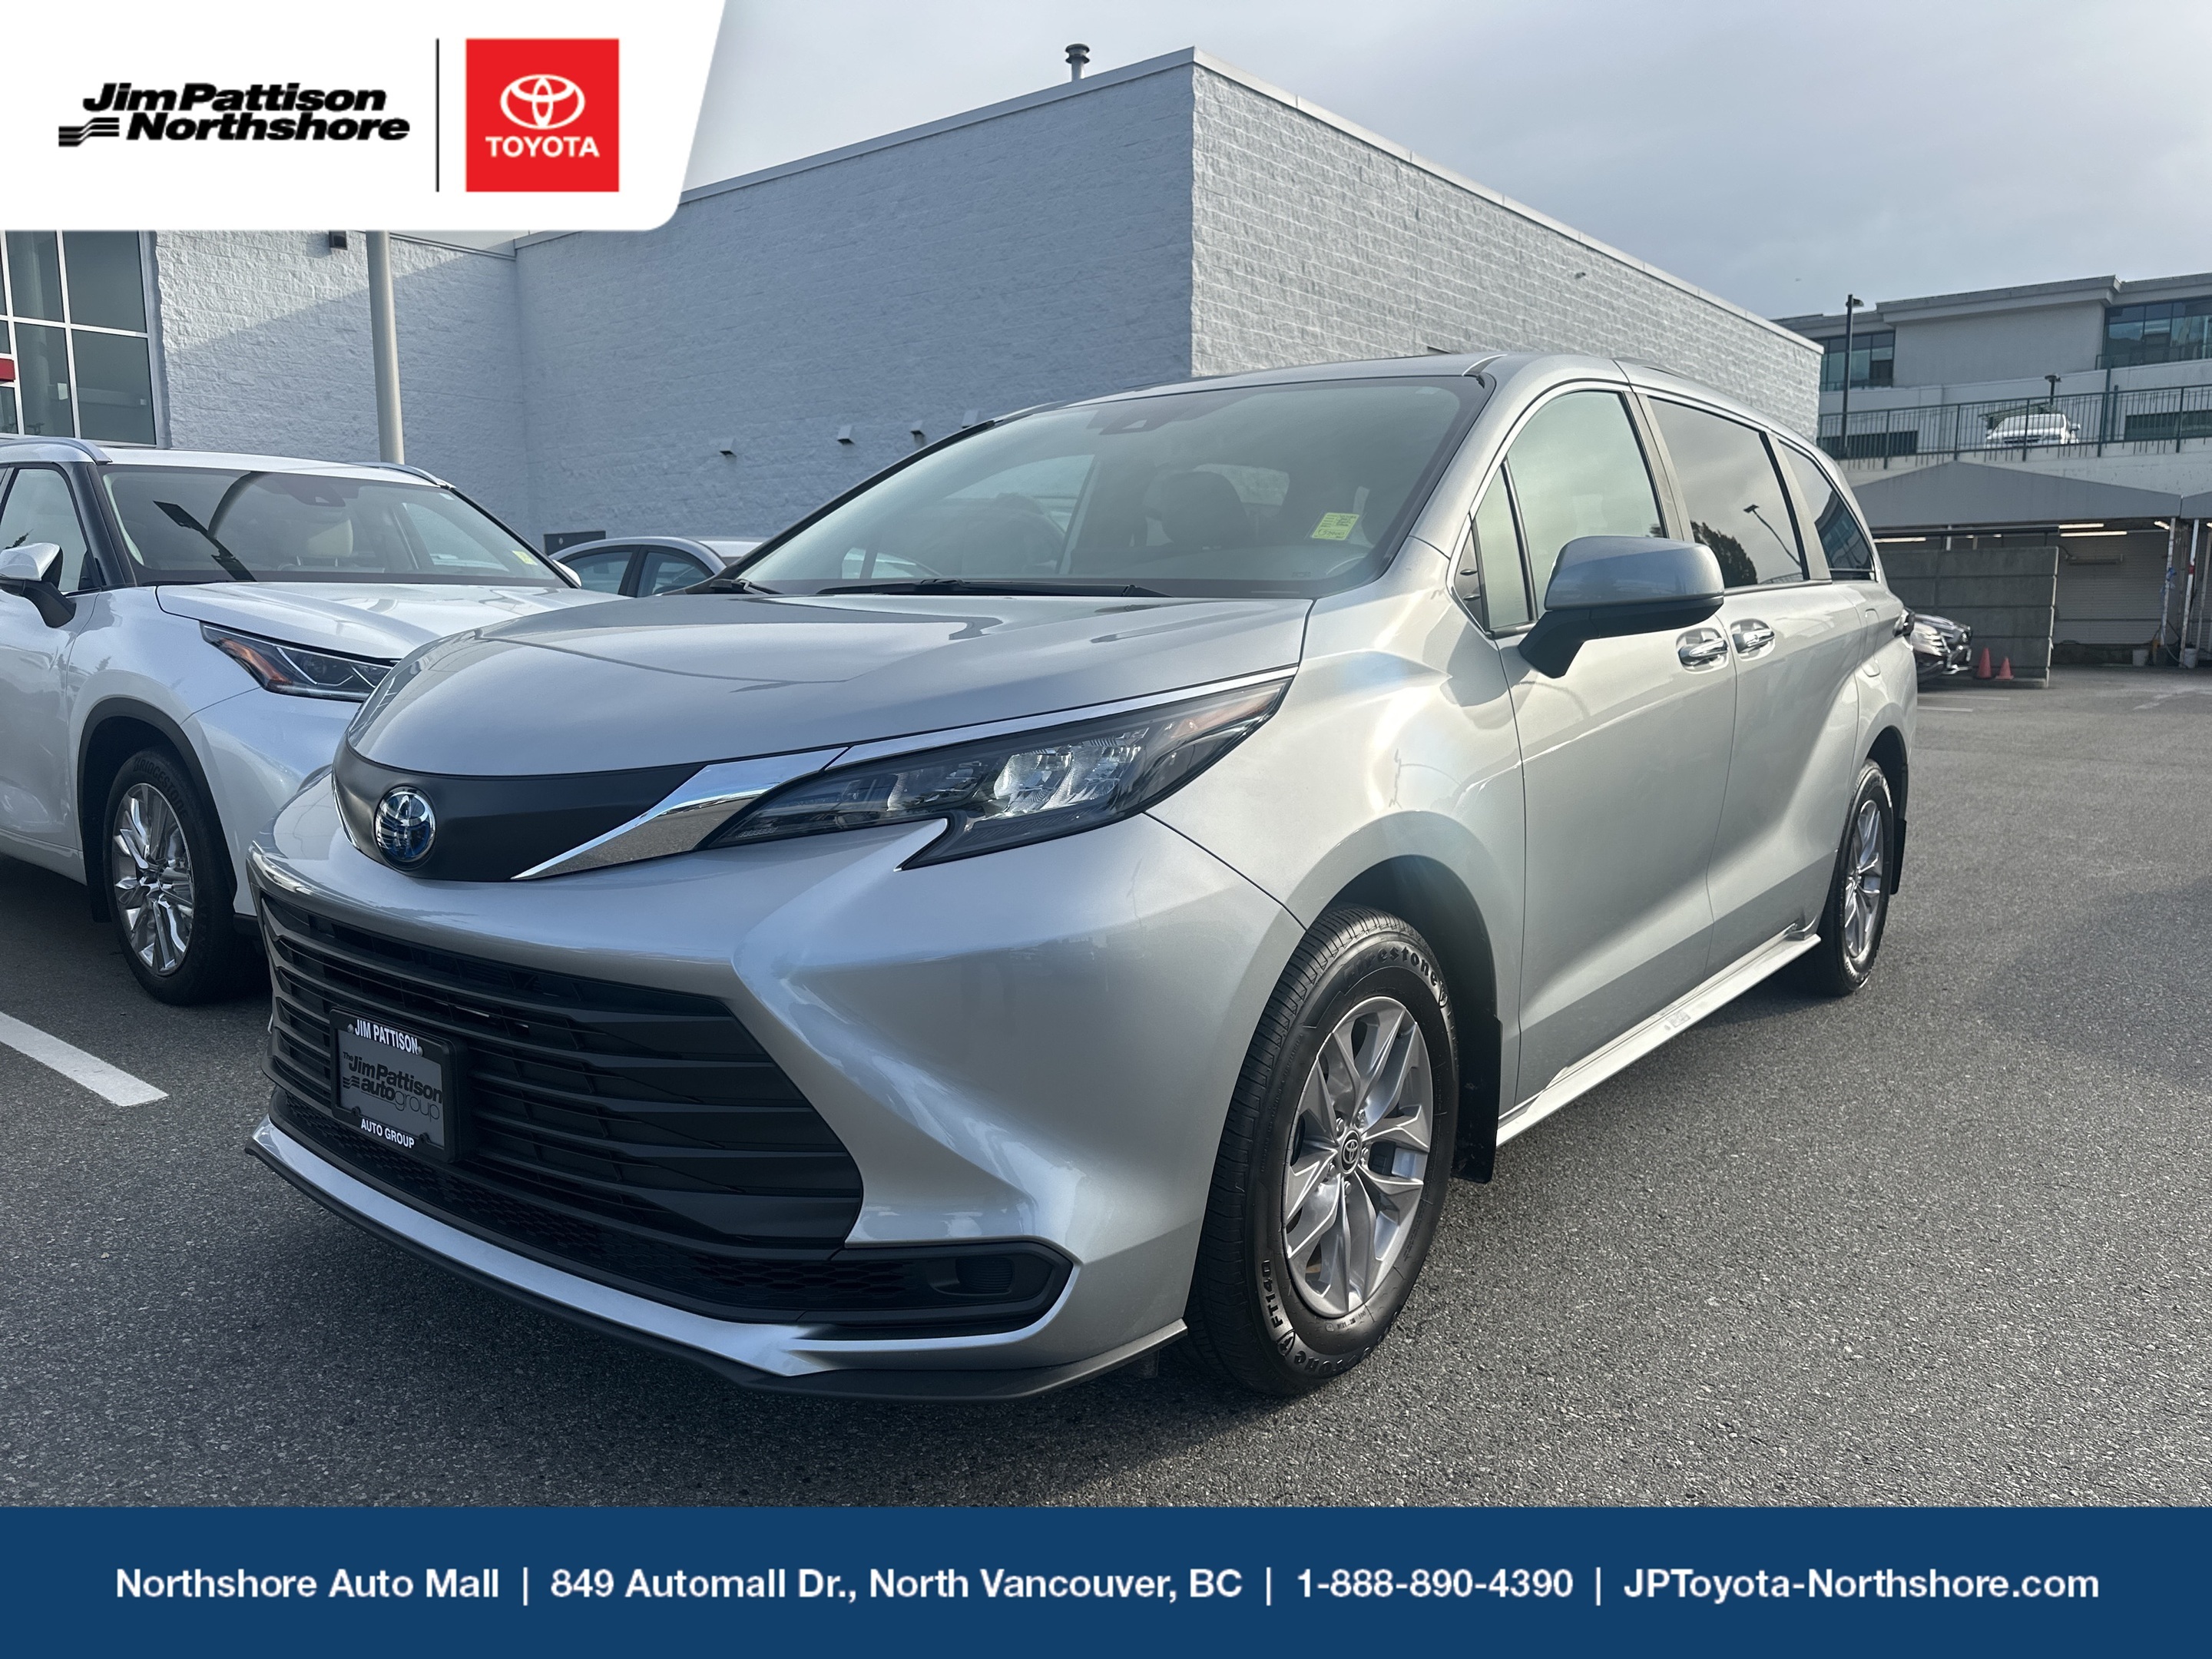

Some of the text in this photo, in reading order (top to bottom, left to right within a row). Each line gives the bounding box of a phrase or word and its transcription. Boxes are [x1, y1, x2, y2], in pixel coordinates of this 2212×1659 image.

[133, 757, 189, 819] BRIDGESTONE
[355, 1019, 418, 1055] JIM PATTISON
[343, 1051, 354, 1061] The
[361, 1118, 415, 1148] AUTO GROUP
